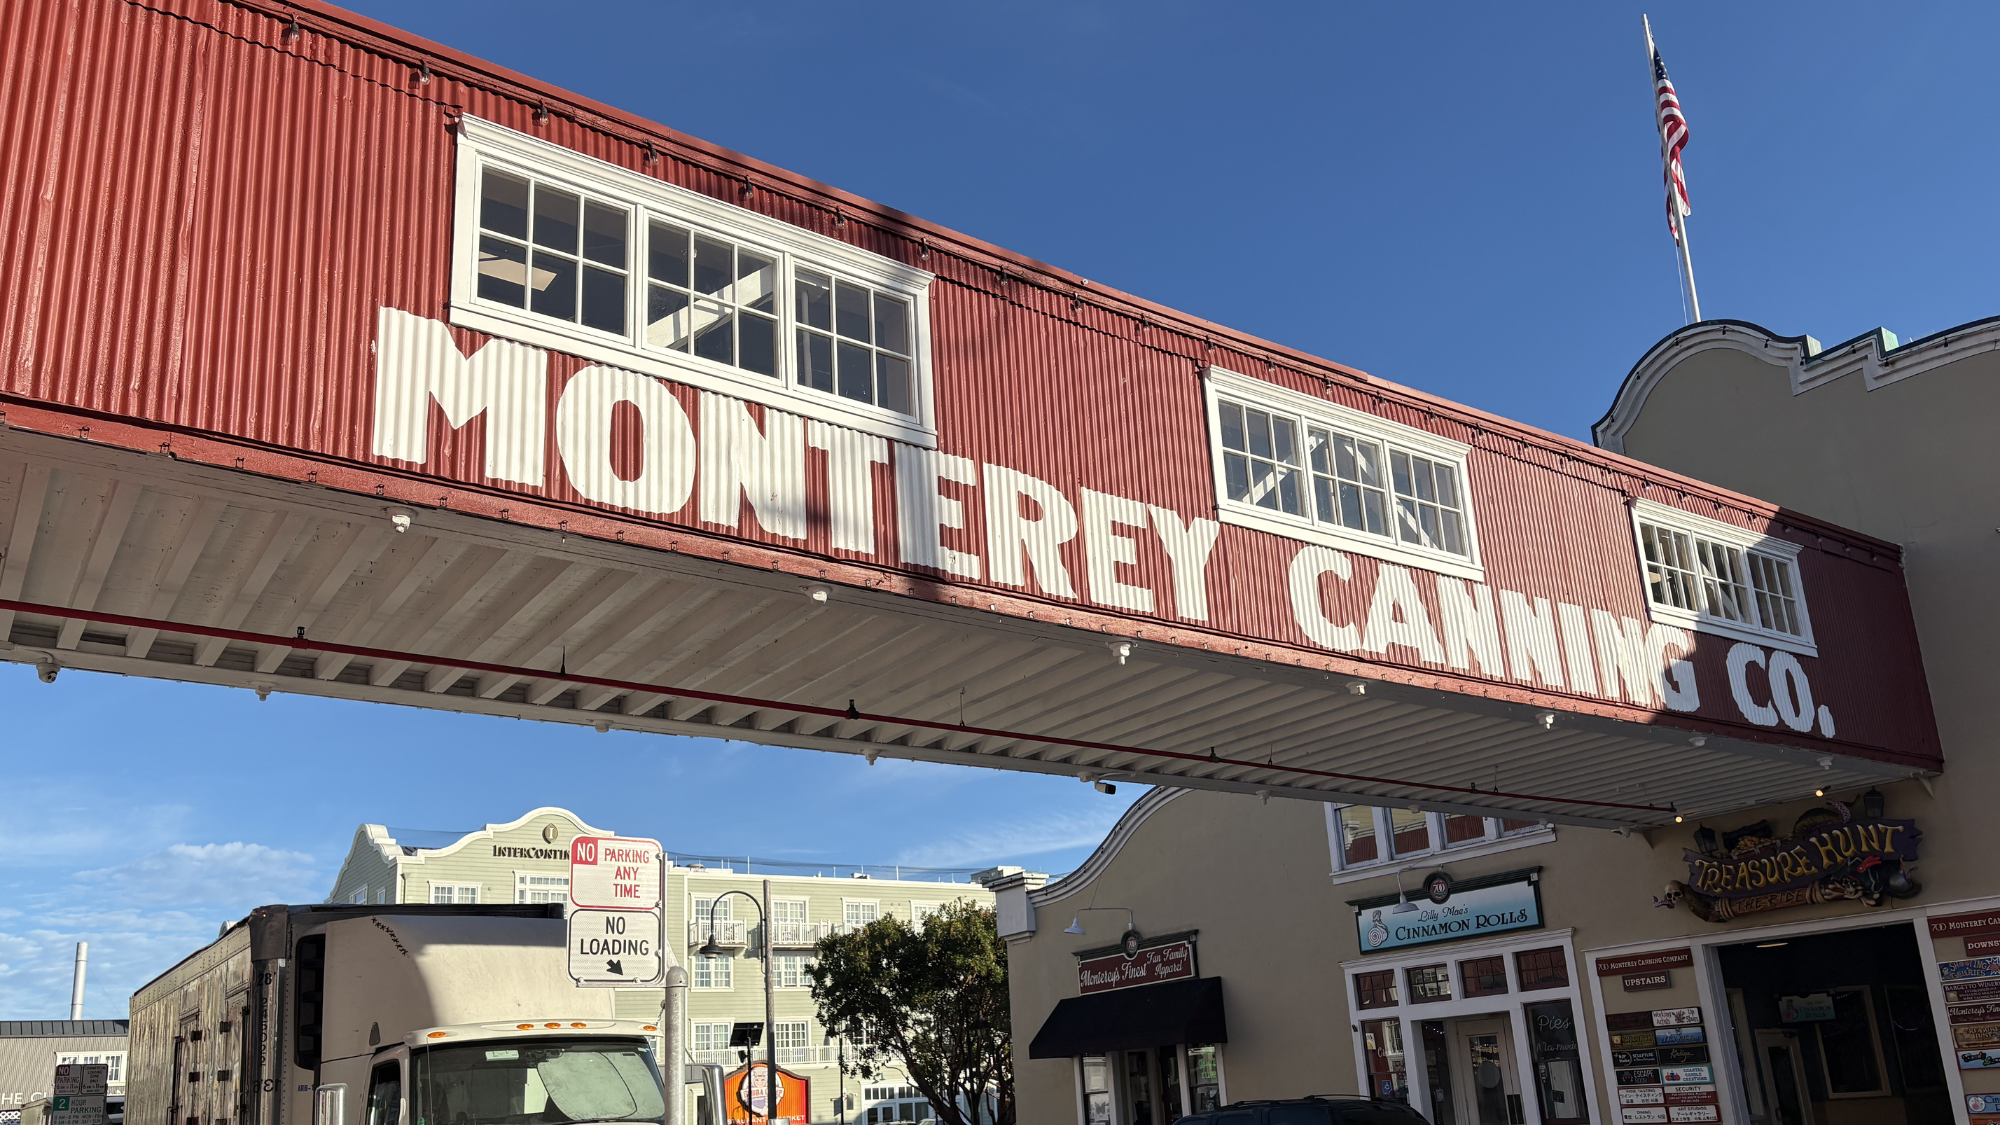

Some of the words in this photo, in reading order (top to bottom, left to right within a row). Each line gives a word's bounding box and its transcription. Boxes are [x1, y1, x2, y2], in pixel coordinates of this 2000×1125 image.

[372, 305, 1220, 621] MONTEREY
[1288, 544, 1701, 713] CANNING
[1725, 642, 1836, 739] CO.
[577, 842, 595, 862] NO
[604, 848, 650, 864] PARKING
[1695, 845, 1818, 893] TREASURE
[1809, 823, 1904, 870] HUNT
[614, 866, 639, 881] ANY
[613, 883, 641, 899] TIME
[1432, 883, 1445, 894] 700
[1736, 898, 1763, 912] THE
[1768, 890, 1805, 907] RIDE
[1418, 909, 1439, 922] Lilly
[1442, 903, 1469, 918] Mae's
[605, 916, 626, 935] NO
[1395, 919, 1471, 941] CINNAMON
[1475, 909, 1528, 929] ROLLS
[1931, 923, 1947, 931] 700
[1949, 919, 1987, 930] MONTEREY
[580, 938, 649, 956] LOADING
[1146, 951, 1161, 964] Fun
[1163, 945, 1188, 961] Family
[1154, 960, 1183, 979] Apparel
[1610, 960, 1637, 970] MONTEREY
[1638, 958, 1662, 966] CANNING
[1662, 955, 1688, 963] COMPANY
[1080, 967, 1120, 988] Monterey's
[1121, 962, 1147, 980] Finest
[1625, 976, 1666, 986] UPSTAIRS
[1537, 1015, 1572, 1032] Pies
[58, 1066, 69, 1075] NO
[1202, 1070, 1217, 1080] rule
[1634, 1069, 1654, 1078] ESCAPE
[58, 1098, 66, 1109] 2
[70, 1106, 102, 1114] PARKING
